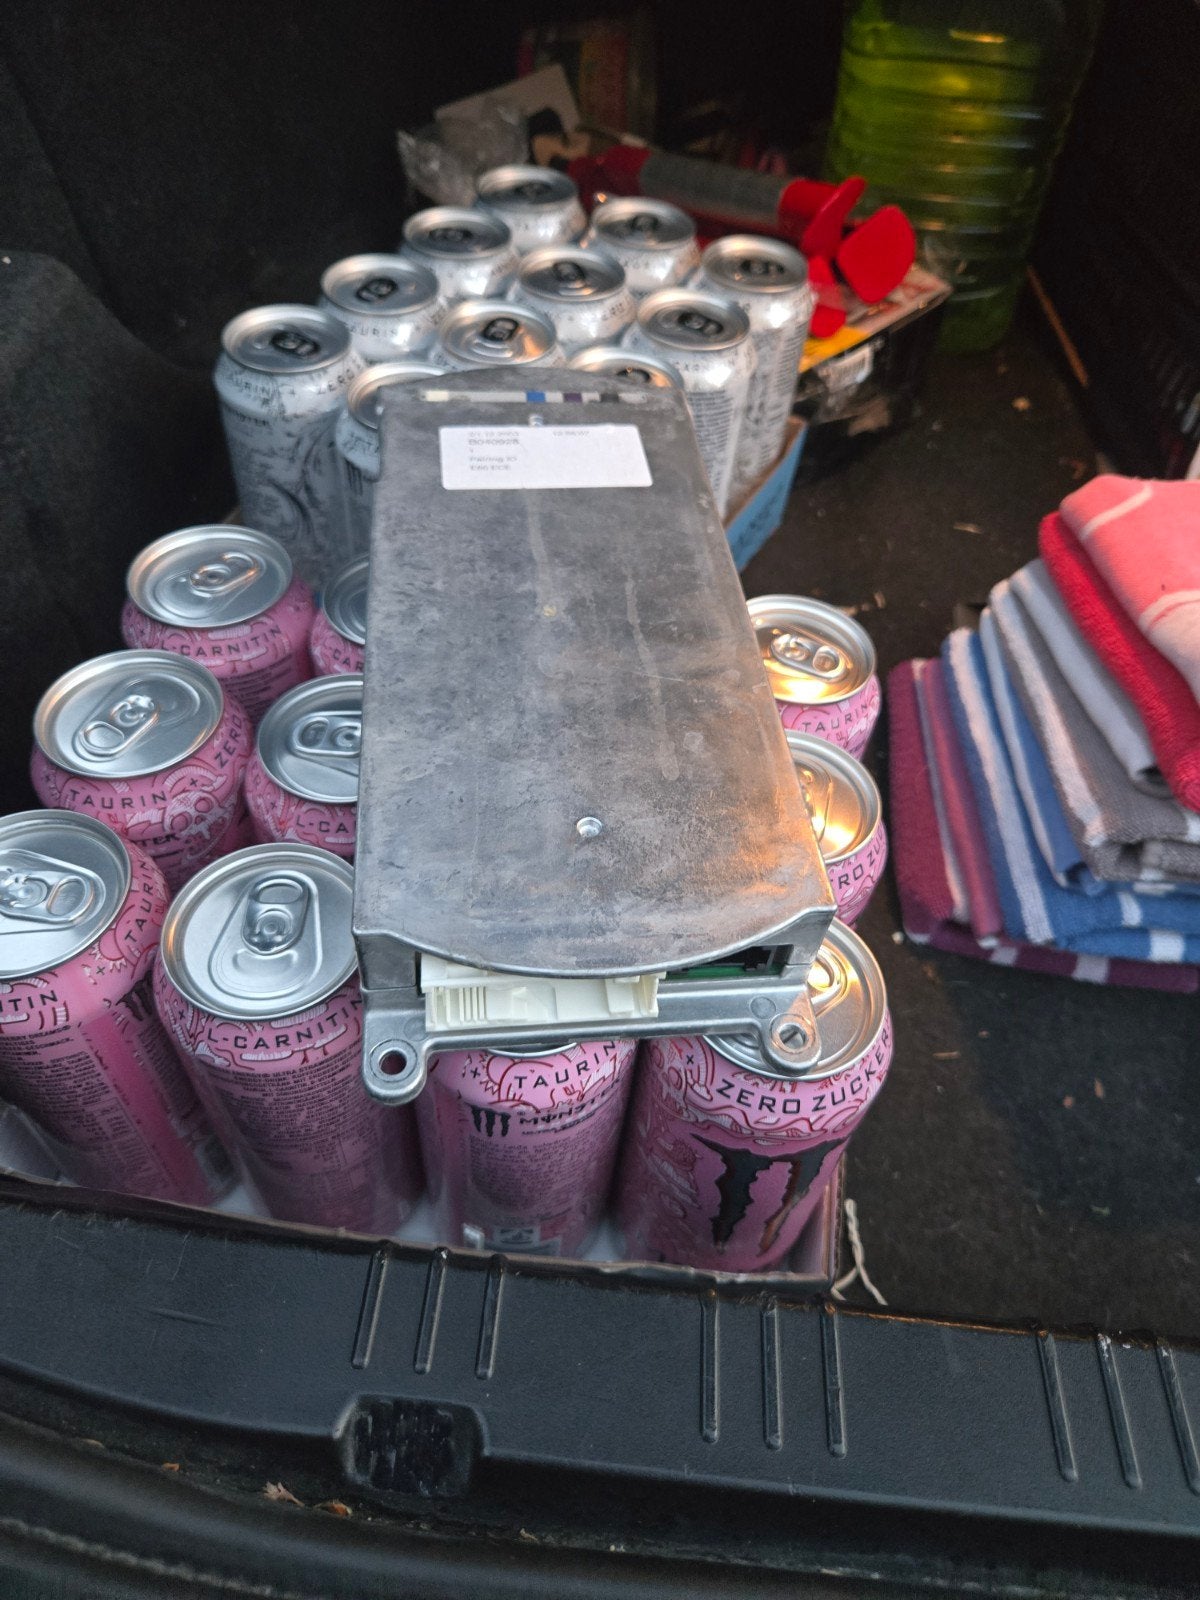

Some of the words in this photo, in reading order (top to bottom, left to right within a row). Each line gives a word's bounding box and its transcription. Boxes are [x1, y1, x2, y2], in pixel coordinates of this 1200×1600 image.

[161, 624, 282, 657] L-CARNITIN
[214, 713, 243, 769] ZERO
[802, 702, 868, 733] TAURIN
[70, 785, 167, 809] TAURIN
[124, 861, 154, 943] TAURIN
[207, 998, 363, 1050] L-CARNITIN
[513, 1040, 616, 1089] TAURIN
[716, 1078, 801, 1115] ZERO
[811, 1028, 890, 1112] ZUCKER
